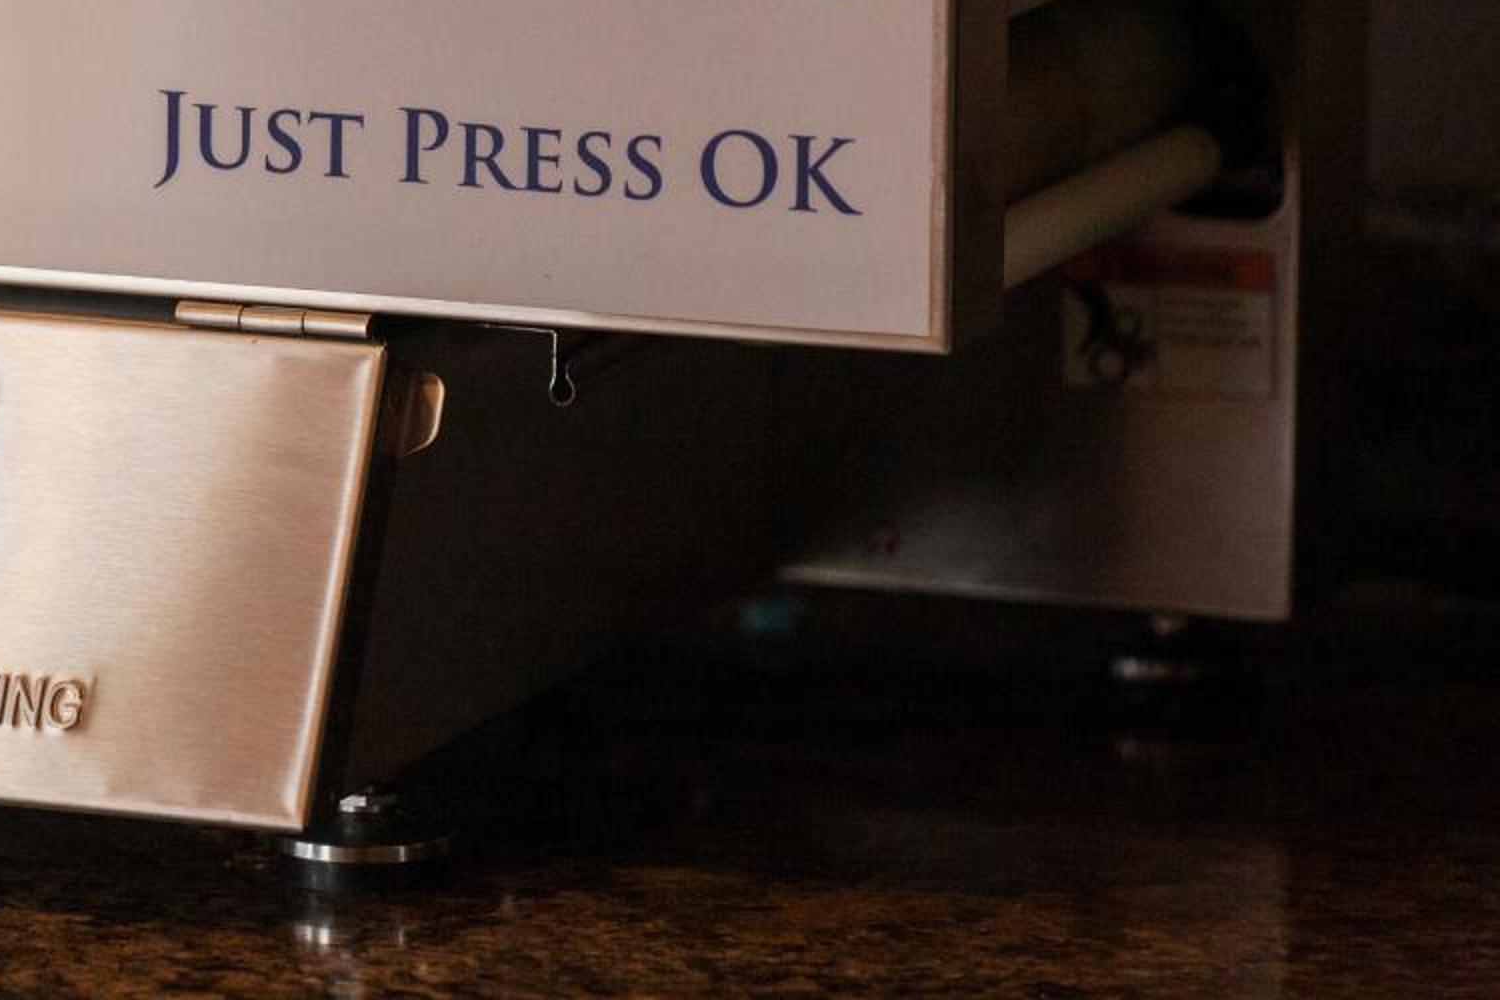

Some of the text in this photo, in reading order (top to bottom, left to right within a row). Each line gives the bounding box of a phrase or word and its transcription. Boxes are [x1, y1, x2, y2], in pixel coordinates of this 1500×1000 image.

[154, 90, 864, 216] JUST PRESS OK
